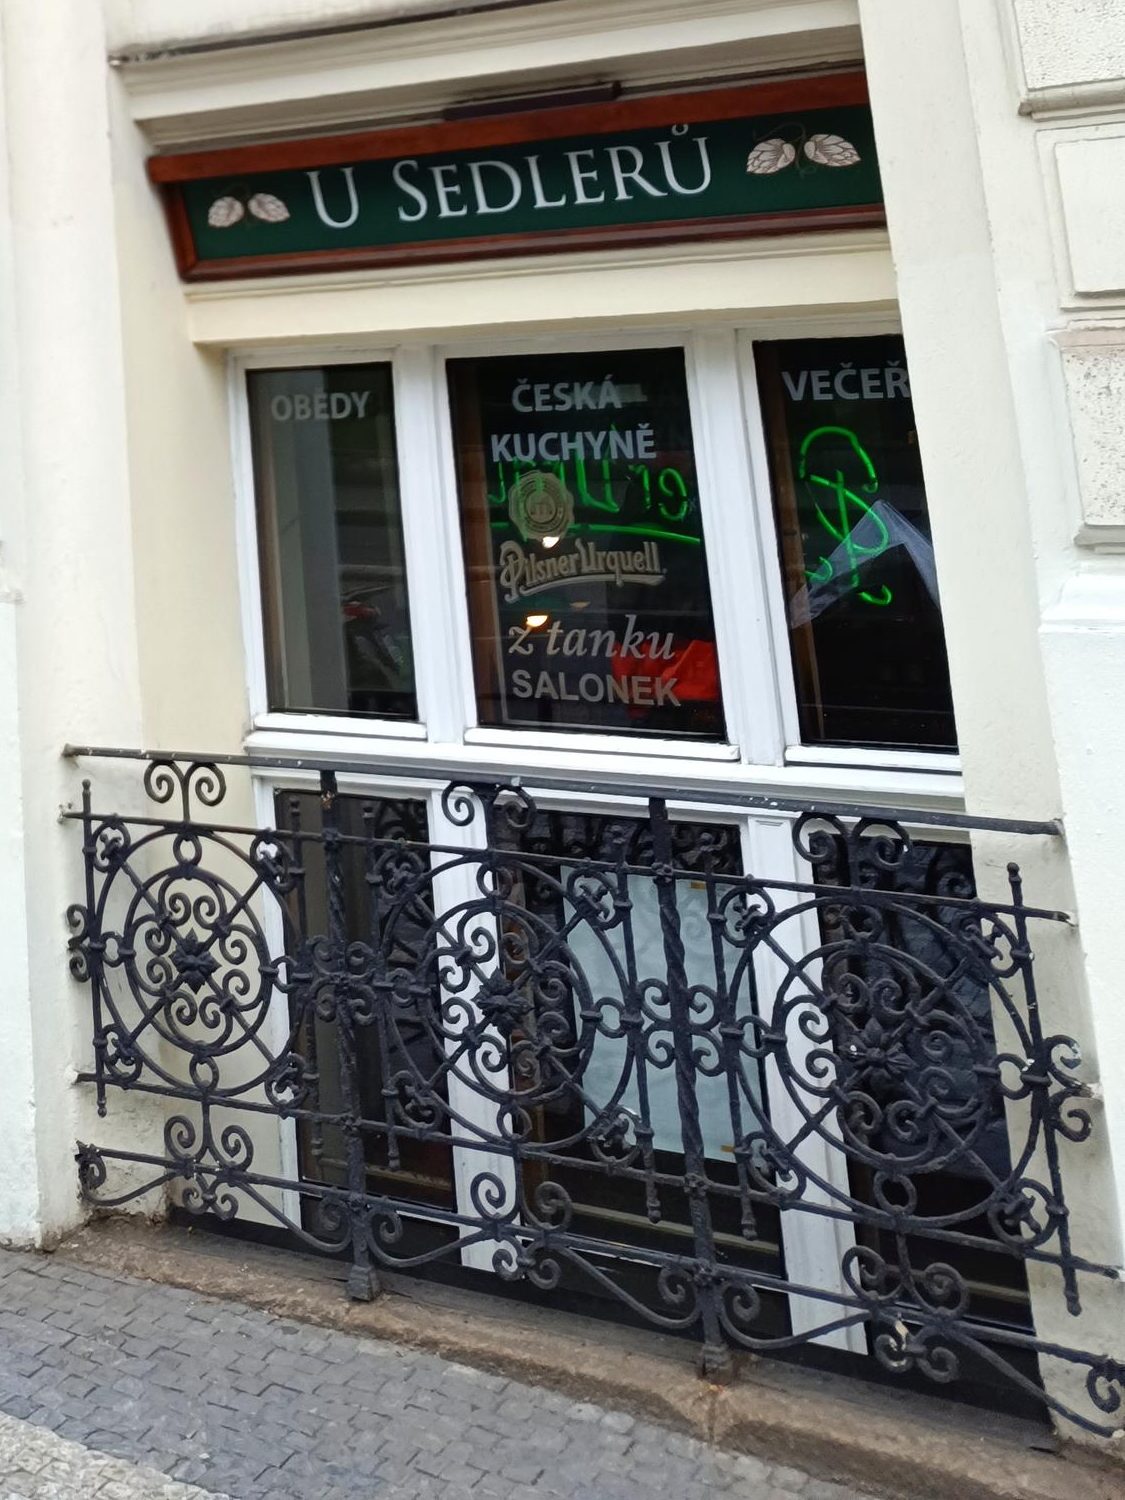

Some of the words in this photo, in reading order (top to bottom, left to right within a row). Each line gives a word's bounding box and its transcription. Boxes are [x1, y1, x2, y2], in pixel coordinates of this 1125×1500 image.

[307, 167, 361, 230] U
[392, 123, 713, 223] SEDLERŮ
[512, 374, 622, 413] ČESKÁ
[491, 423, 657, 462] KUCHYNĚ
[500, 540, 578, 603] Pilsner
[575, 538, 668, 587] Urquell
[508, 626, 533, 655] z
[546, 614, 676, 659] tanku
[512, 669, 681, 707] SALONEK
